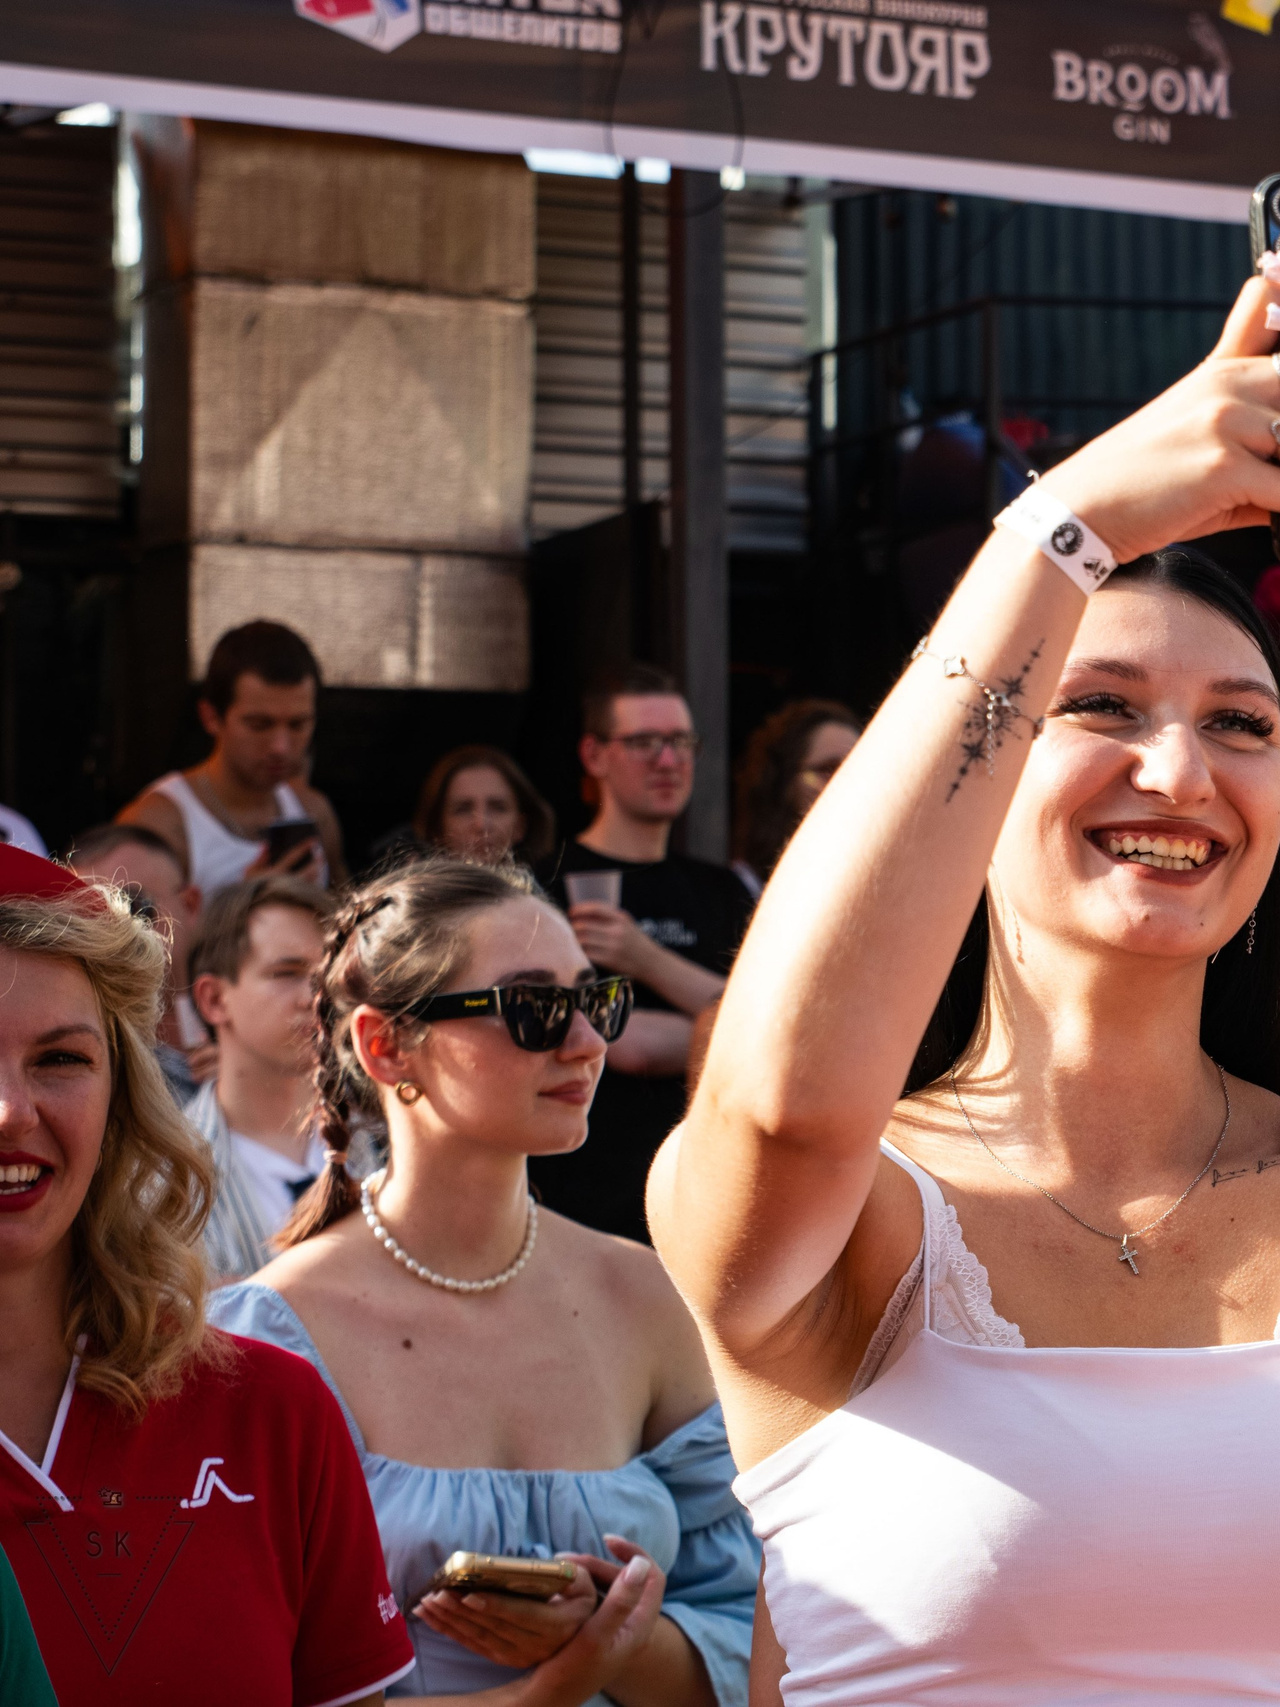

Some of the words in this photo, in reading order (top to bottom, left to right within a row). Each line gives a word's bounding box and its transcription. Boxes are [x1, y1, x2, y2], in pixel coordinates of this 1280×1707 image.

[702, 2, 992, 99] КРУТОЯР
[1051, 49, 1231, 119] BROOM
[1113, 113, 1171, 144] GIN
